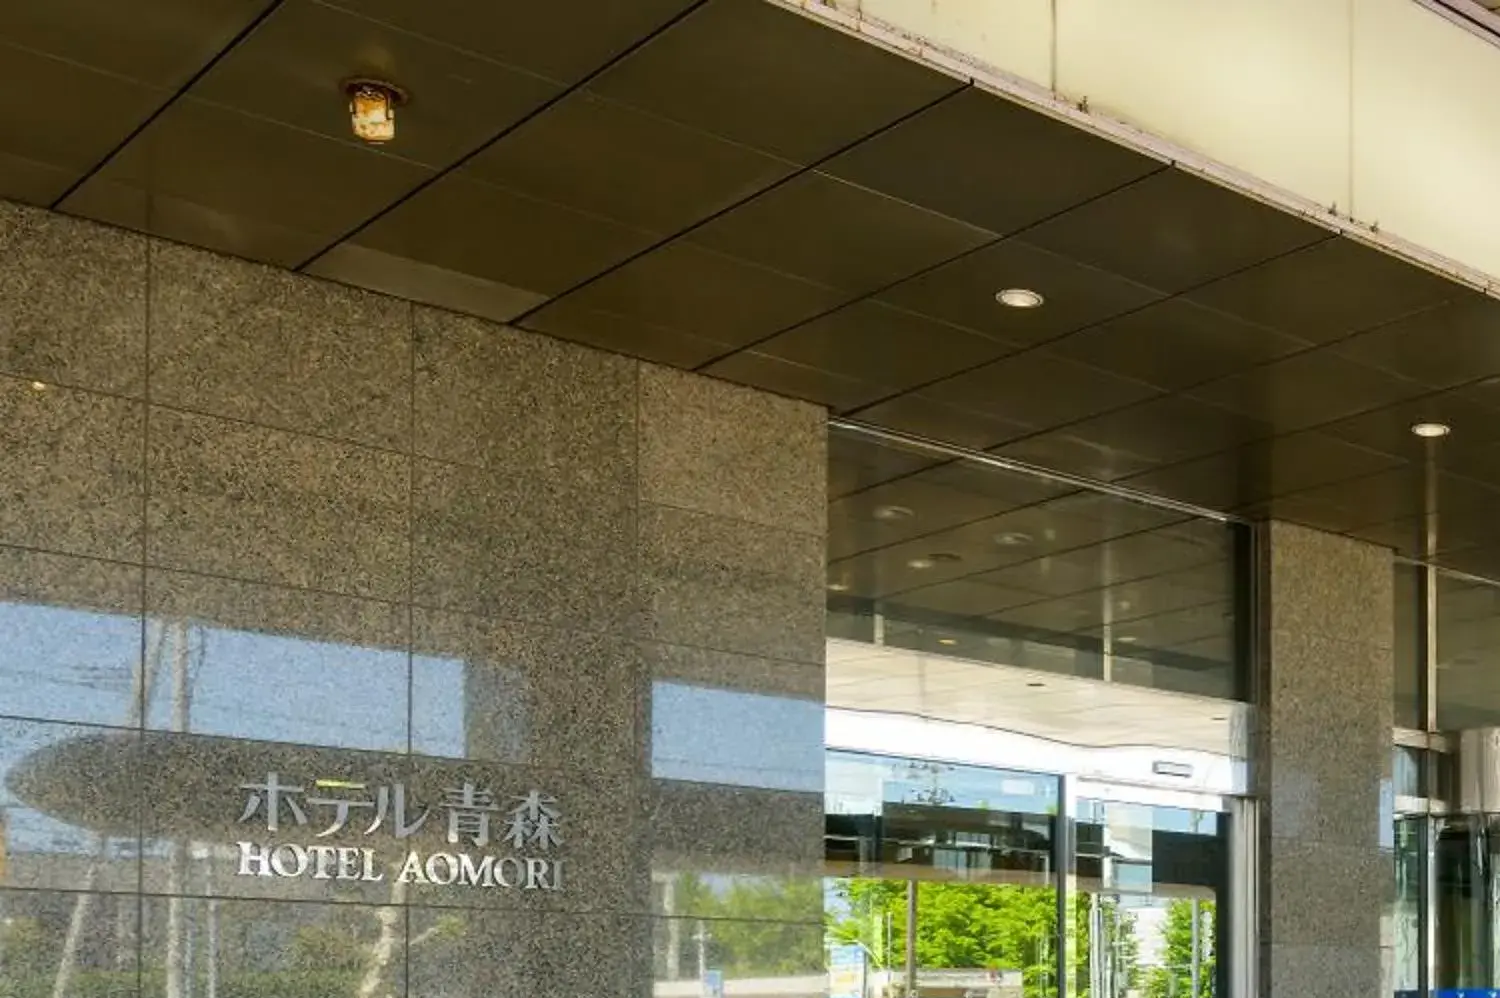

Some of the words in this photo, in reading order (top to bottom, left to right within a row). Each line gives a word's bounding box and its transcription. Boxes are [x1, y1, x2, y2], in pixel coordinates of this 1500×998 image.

[238, 771, 566, 849] ホテル青森
[235, 841, 383, 882] HOTEL
[398, 852, 566, 890] AOMORI
